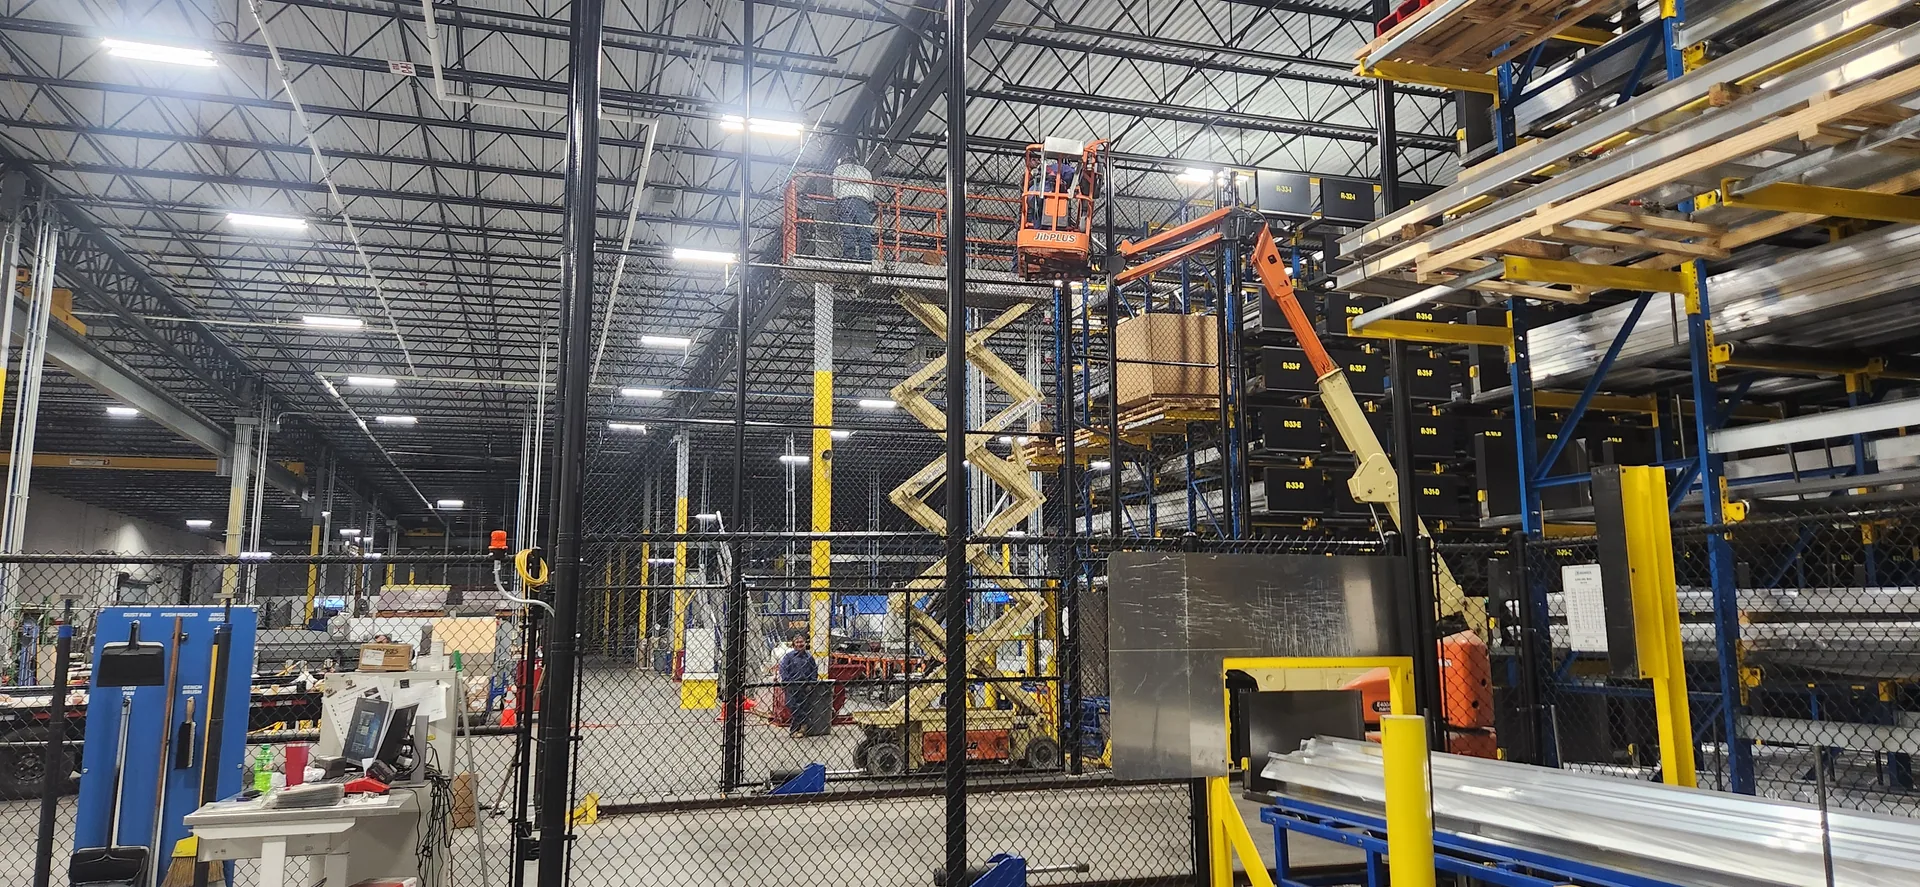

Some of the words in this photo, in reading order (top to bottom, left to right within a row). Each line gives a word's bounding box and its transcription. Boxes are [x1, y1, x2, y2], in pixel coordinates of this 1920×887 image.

[1275, 184, 1292, 193] R-33-I
[1340, 191, 1356, 201] R-32-I
[1034, 232, 1076, 243] JibPLUS
[1282, 361, 1301, 371] R-33-F
[1349, 364, 1367, 373] R-32-F
[1417, 368, 1433, 378] R-31-F
[1283, 420, 1302, 429] R-33-E
[1285, 481, 1305, 490] R-33-D
[1423, 487, 1440, 496] R-31-D
